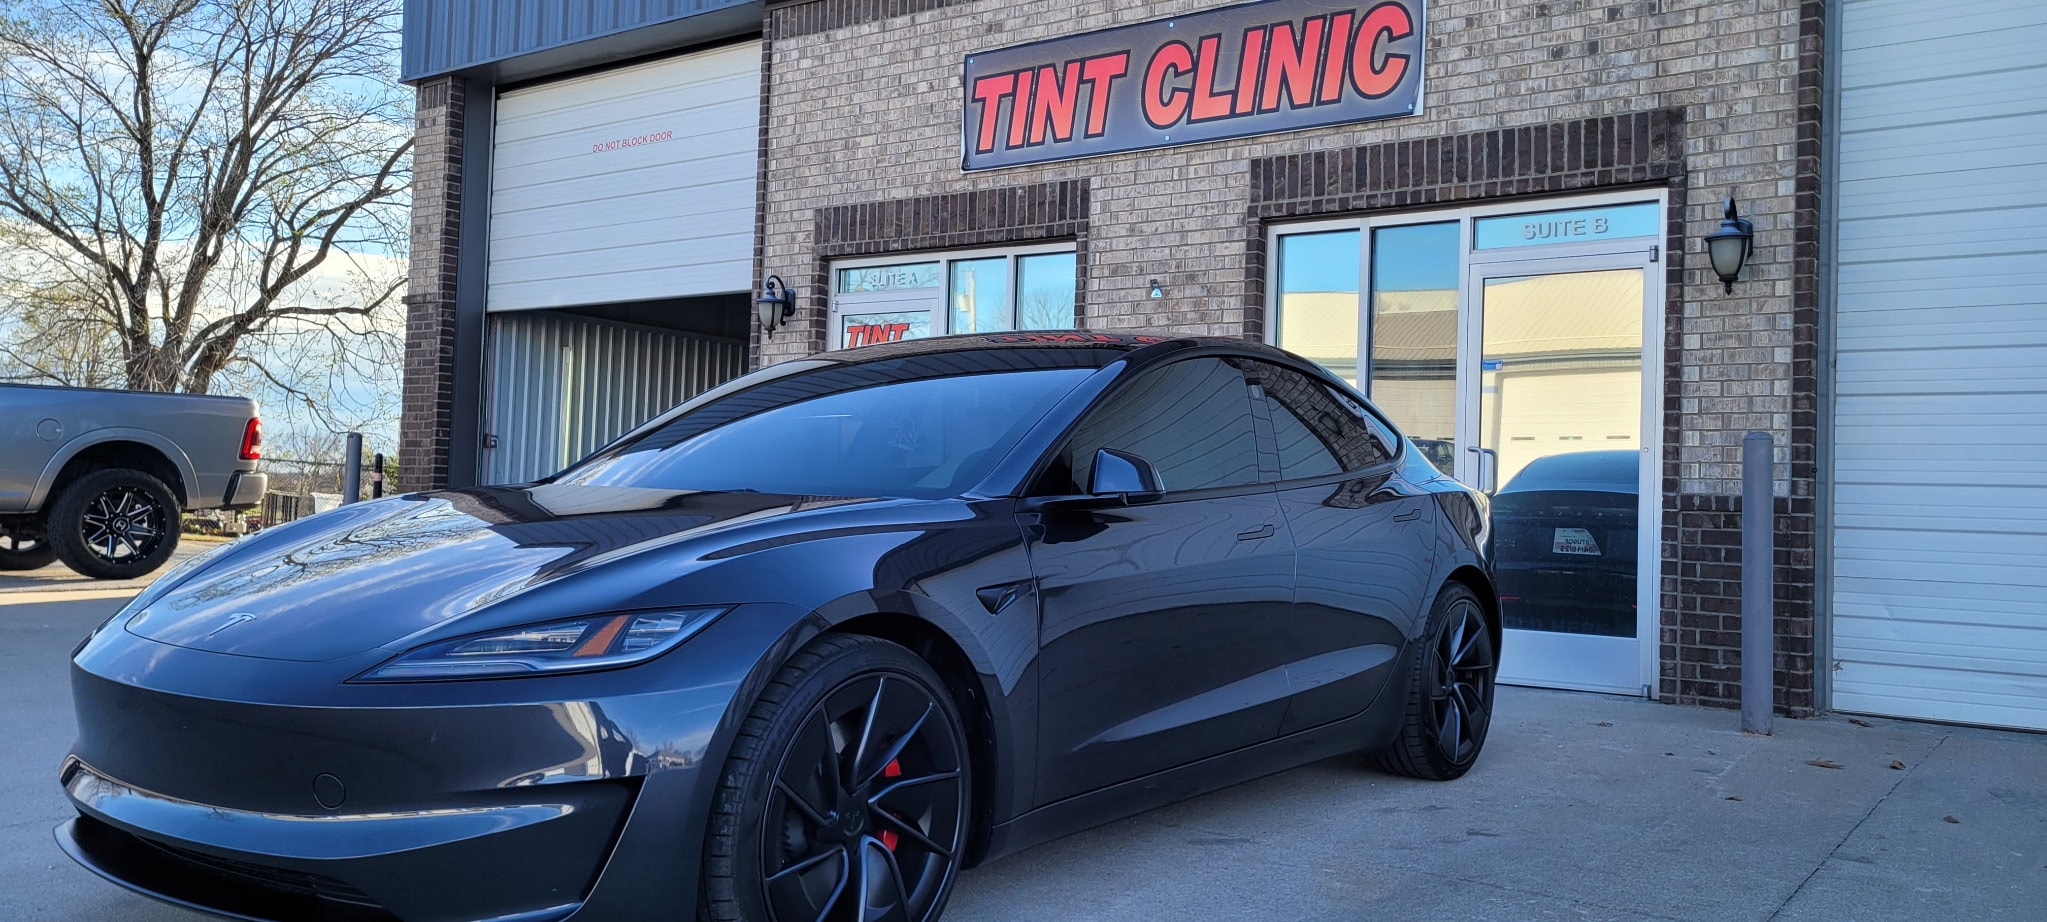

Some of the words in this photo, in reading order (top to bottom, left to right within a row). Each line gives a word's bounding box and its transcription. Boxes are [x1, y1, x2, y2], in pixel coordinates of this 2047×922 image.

[971, 49, 1131, 155] TINT
[1141, 0, 1414, 130] CLINIC
[592, 143, 604, 153] DO
[605, 140, 621, 151] NOT
[622, 135, 648, 147] BLOCK
[649, 130, 673, 143] DOOR
[1522, 218, 1586, 240] SUITE
[1592, 216, 1609, 234] B
[908, 271, 918, 285] A
[847, 323, 910, 349] TINT
